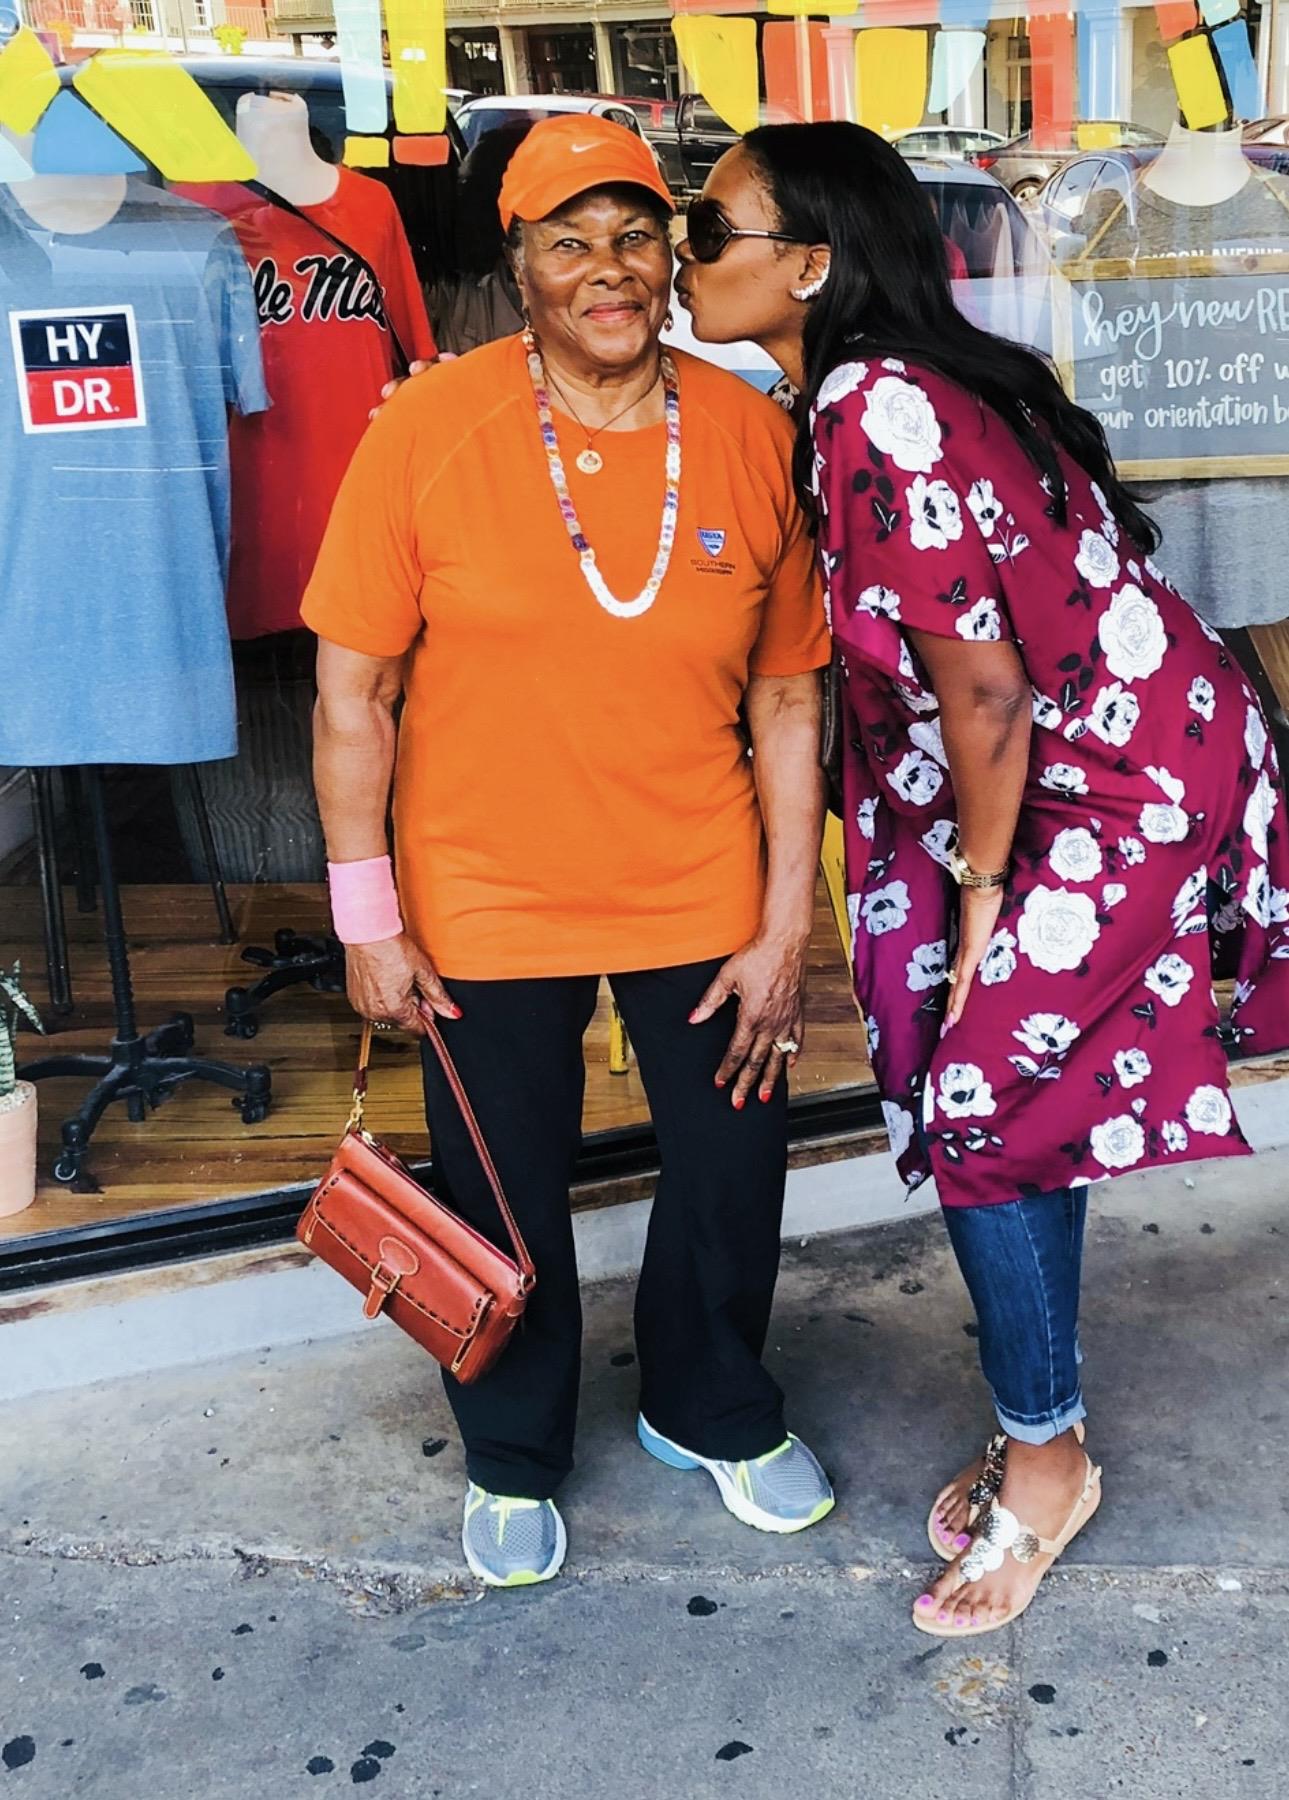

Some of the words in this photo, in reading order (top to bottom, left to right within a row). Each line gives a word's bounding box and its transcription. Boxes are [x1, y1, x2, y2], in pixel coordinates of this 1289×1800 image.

[248, 256, 295, 328] le
[45, 323, 103, 362] HY
[1082, 290, 1177, 361] hey
[1176, 298, 1254, 329] new
[52, 377, 120, 417] DR.
[1100, 359, 1144, 401] get
[1164, 356, 1212, 389] 10%
[1219, 352, 1265, 385] off
[1096, 410, 1134, 429] our
[1144, 394, 1268, 429] orientation
